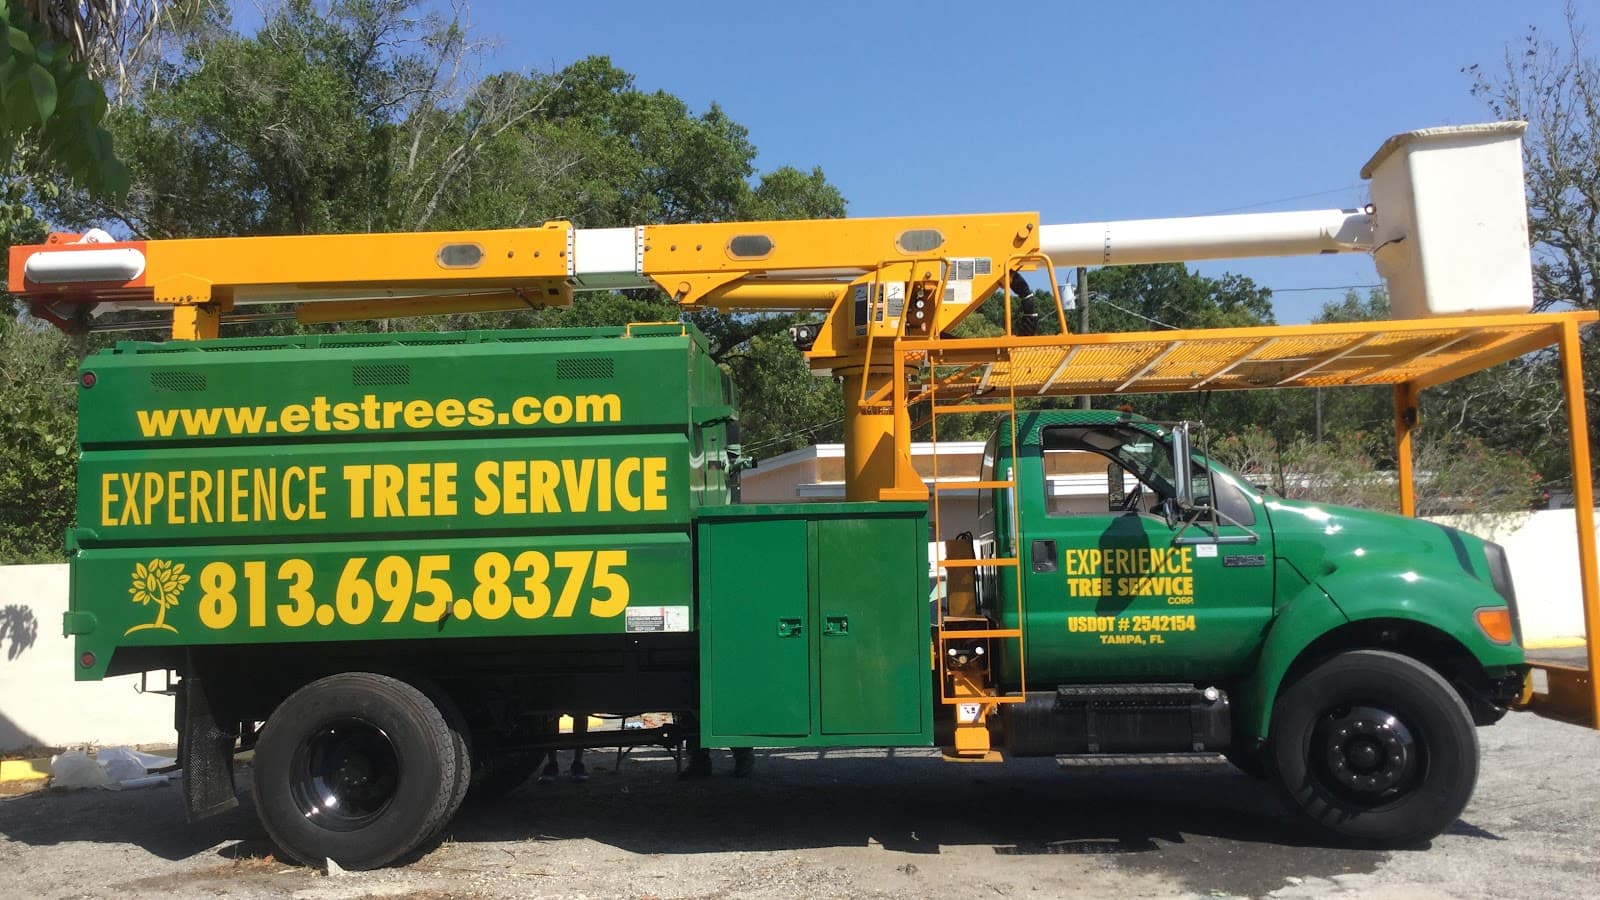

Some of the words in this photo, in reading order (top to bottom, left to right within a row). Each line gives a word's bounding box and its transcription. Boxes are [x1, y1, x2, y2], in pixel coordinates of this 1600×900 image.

[136, 393, 621, 437] www.etstrees.com
[101, 465, 326, 527] EXPERIENCE
[342, 462, 458, 519] TREE
[473, 456, 667, 516] SERVICE
[1066, 548, 1192, 575] EXPERIENCE
[198, 549, 630, 630] 813.695.8375
[1067, 577, 1112, 597] TREE
[1117, 576, 1193, 597] SERVICE
[1068, 616, 1116, 632] USDOT
[1118, 617, 1130, 631] #
[1132, 615, 1196, 632] 2542154
[1099, 634, 1147, 646] TAMPA,
[1149, 634, 1165, 644] FL
